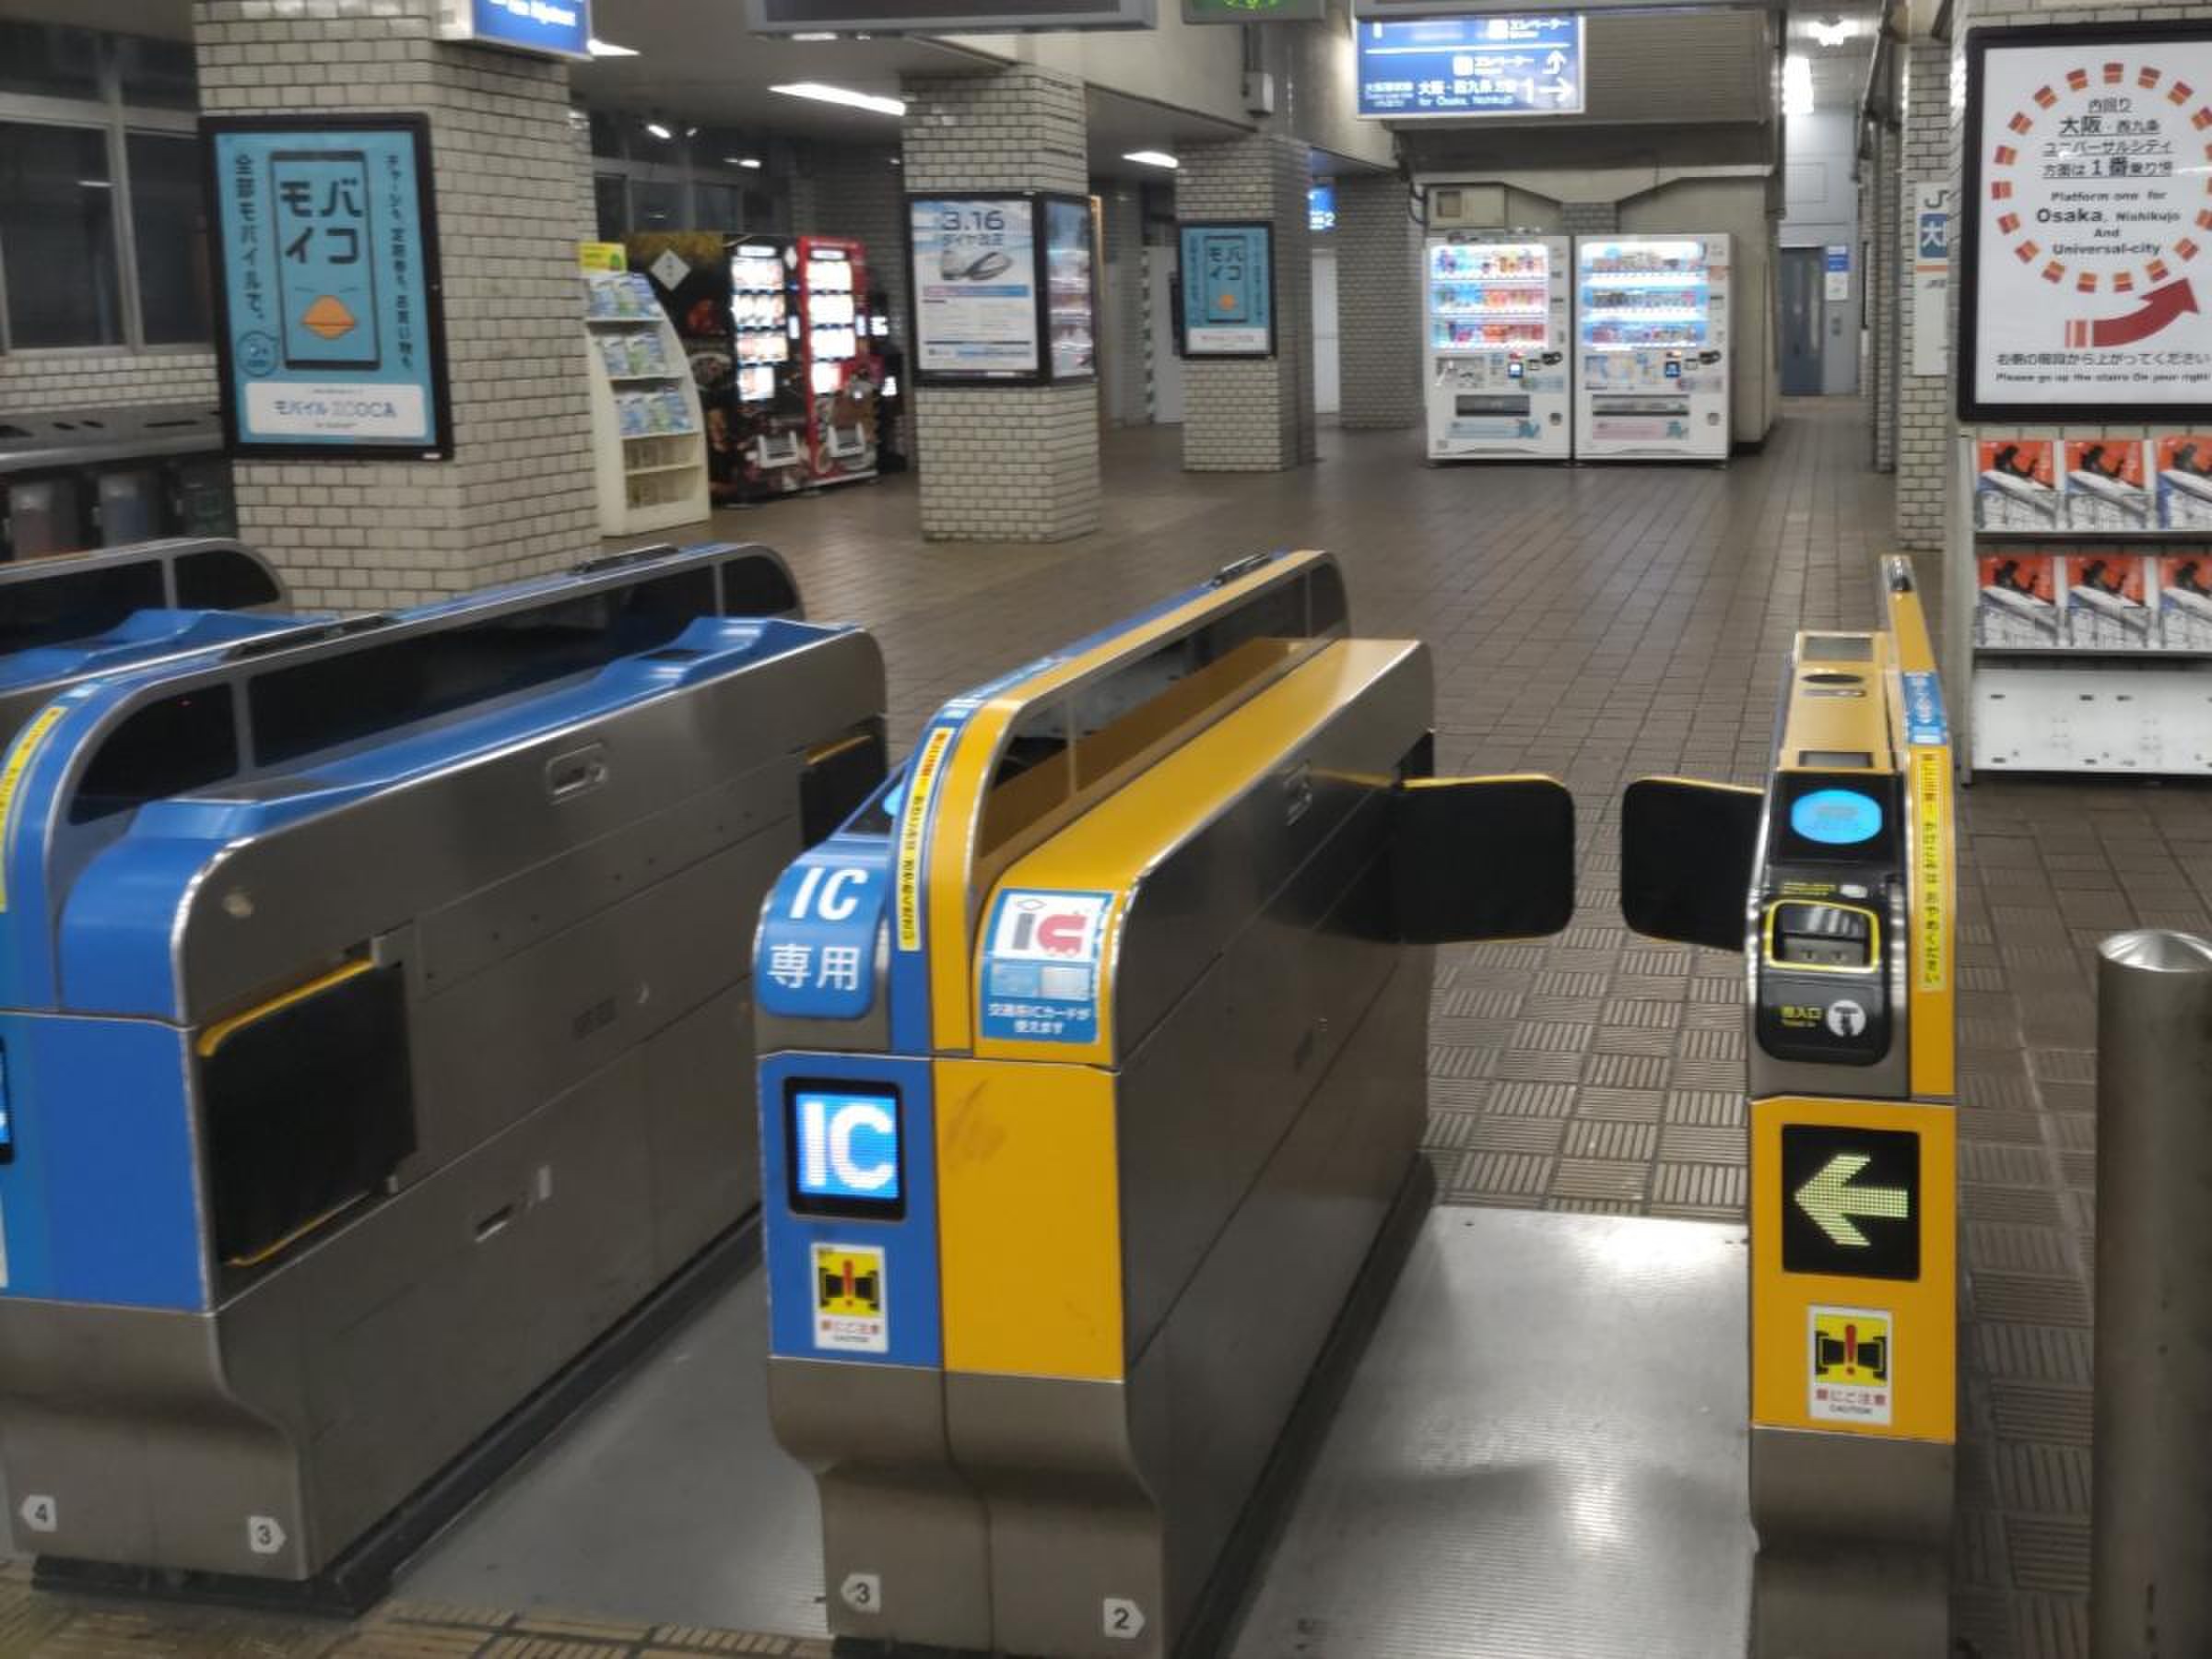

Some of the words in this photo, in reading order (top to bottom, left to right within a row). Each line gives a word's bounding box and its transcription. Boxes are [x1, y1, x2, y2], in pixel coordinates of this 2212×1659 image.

[279, 178, 363, 218] モバ
[2051, 191, 2110, 202] Platform
[2114, 192, 2139, 201] one
[2147, 189, 2168, 200] for
[943, 210, 1005, 230] 3.16
[2093, 228, 2120, 239] And
[285, 227, 361, 265] イコ
[791, 868, 867, 920] IC
[768, 944, 860, 992] 専用
[804, 1100, 895, 1190] IC
[34, 1503, 46, 1522] 4
[258, 1524, 272, 1546] 3
[855, 1583, 870, 1604] 3
[1113, 1607, 1129, 1630] 2
